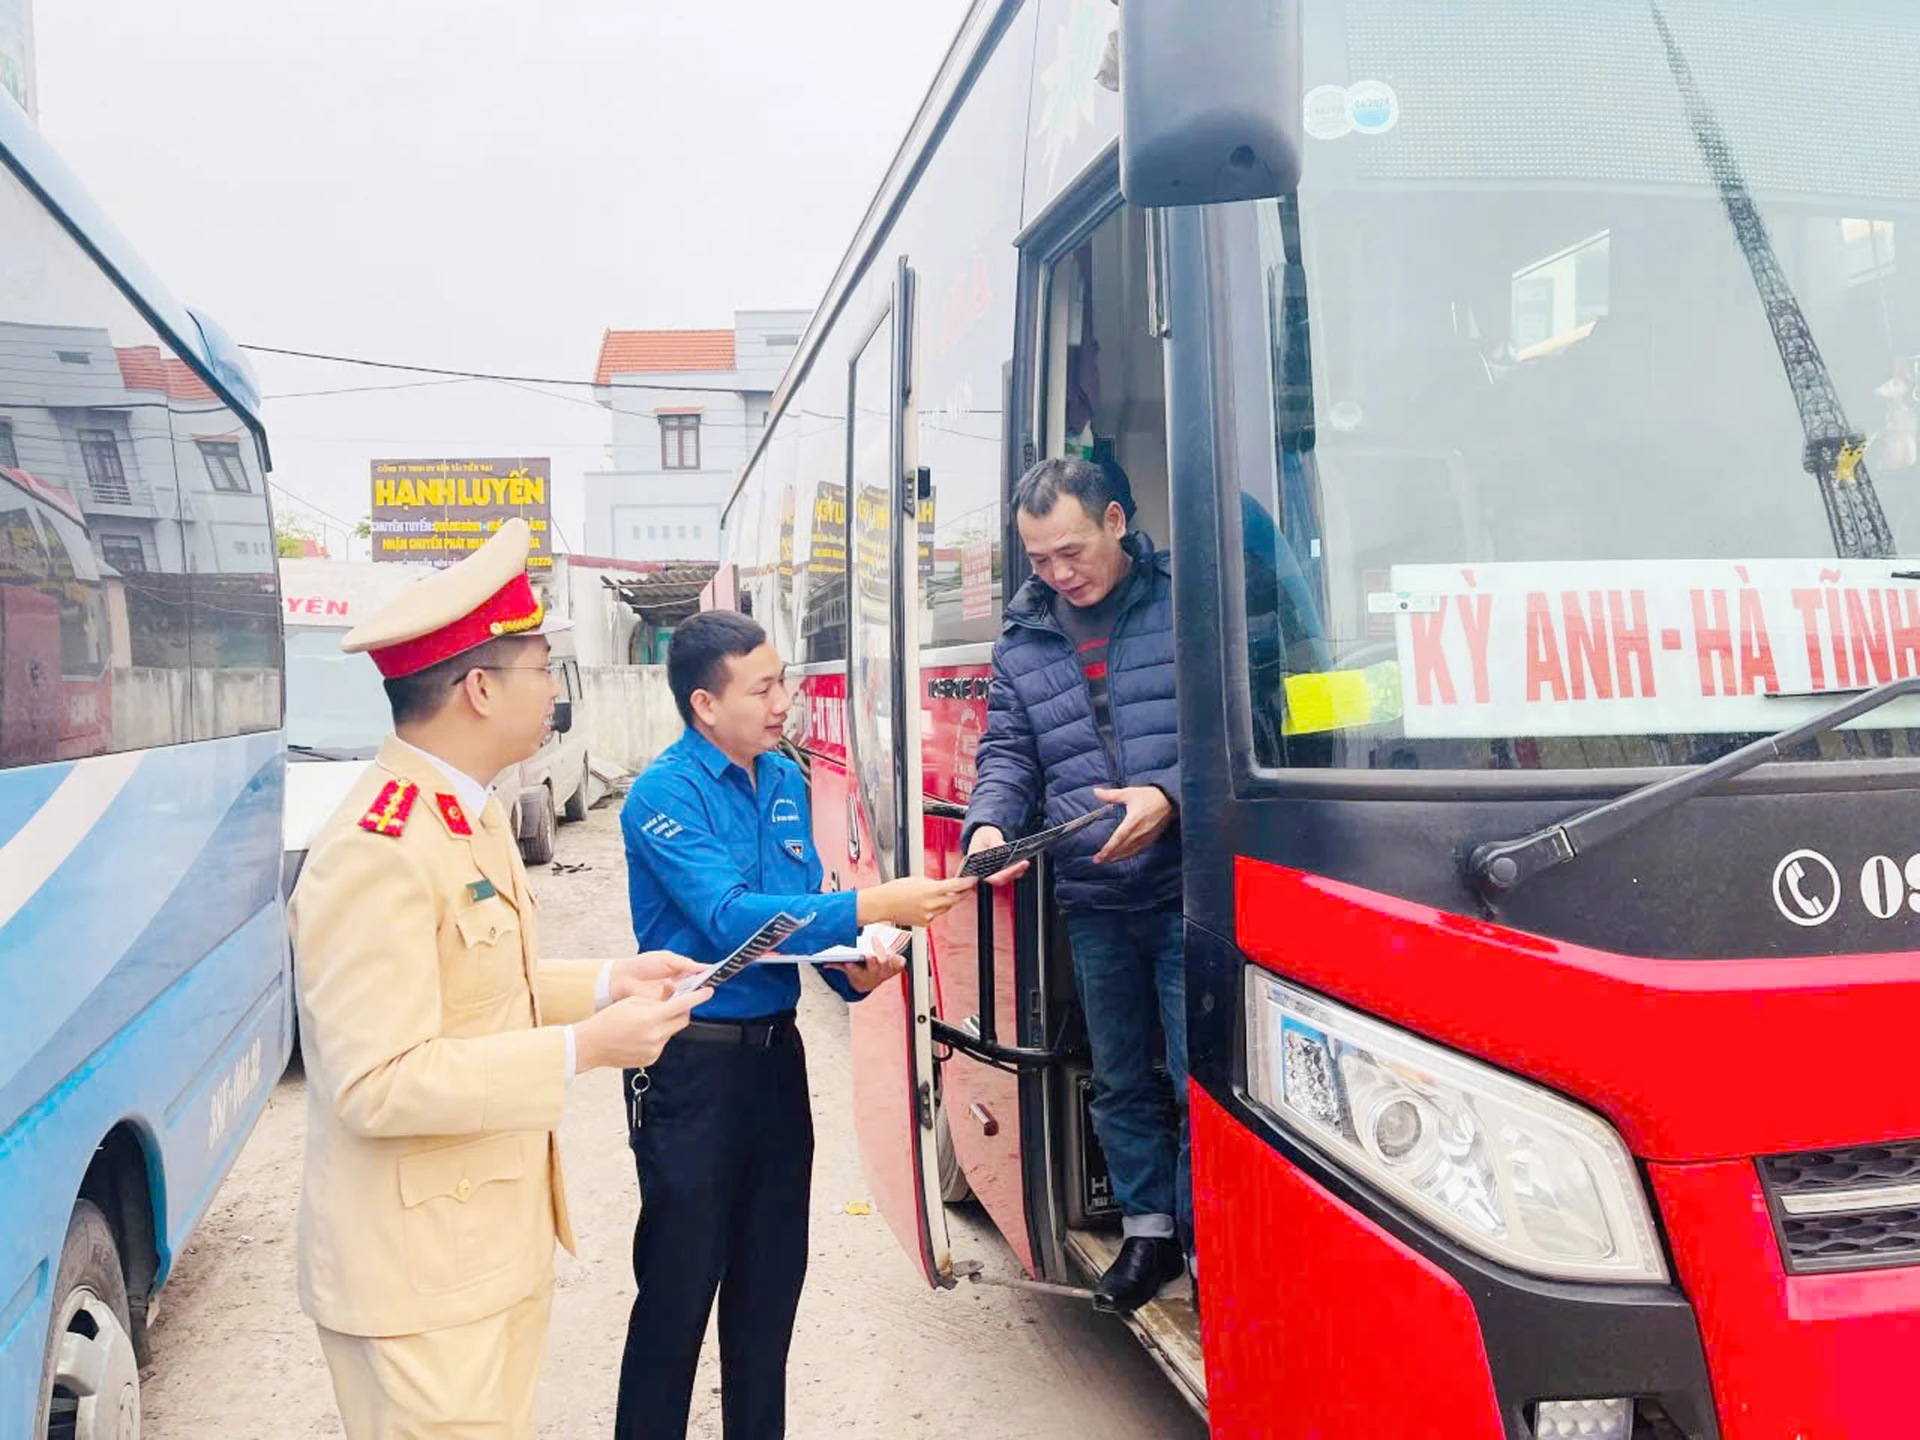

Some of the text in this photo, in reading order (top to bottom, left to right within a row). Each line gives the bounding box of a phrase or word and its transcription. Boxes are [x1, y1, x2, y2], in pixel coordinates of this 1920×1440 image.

[375, 467, 545, 511] HẠNH LUYẾN
[1410, 570, 1492, 706] KỲ
[1792, 568, 1920, 690] TĨNH
